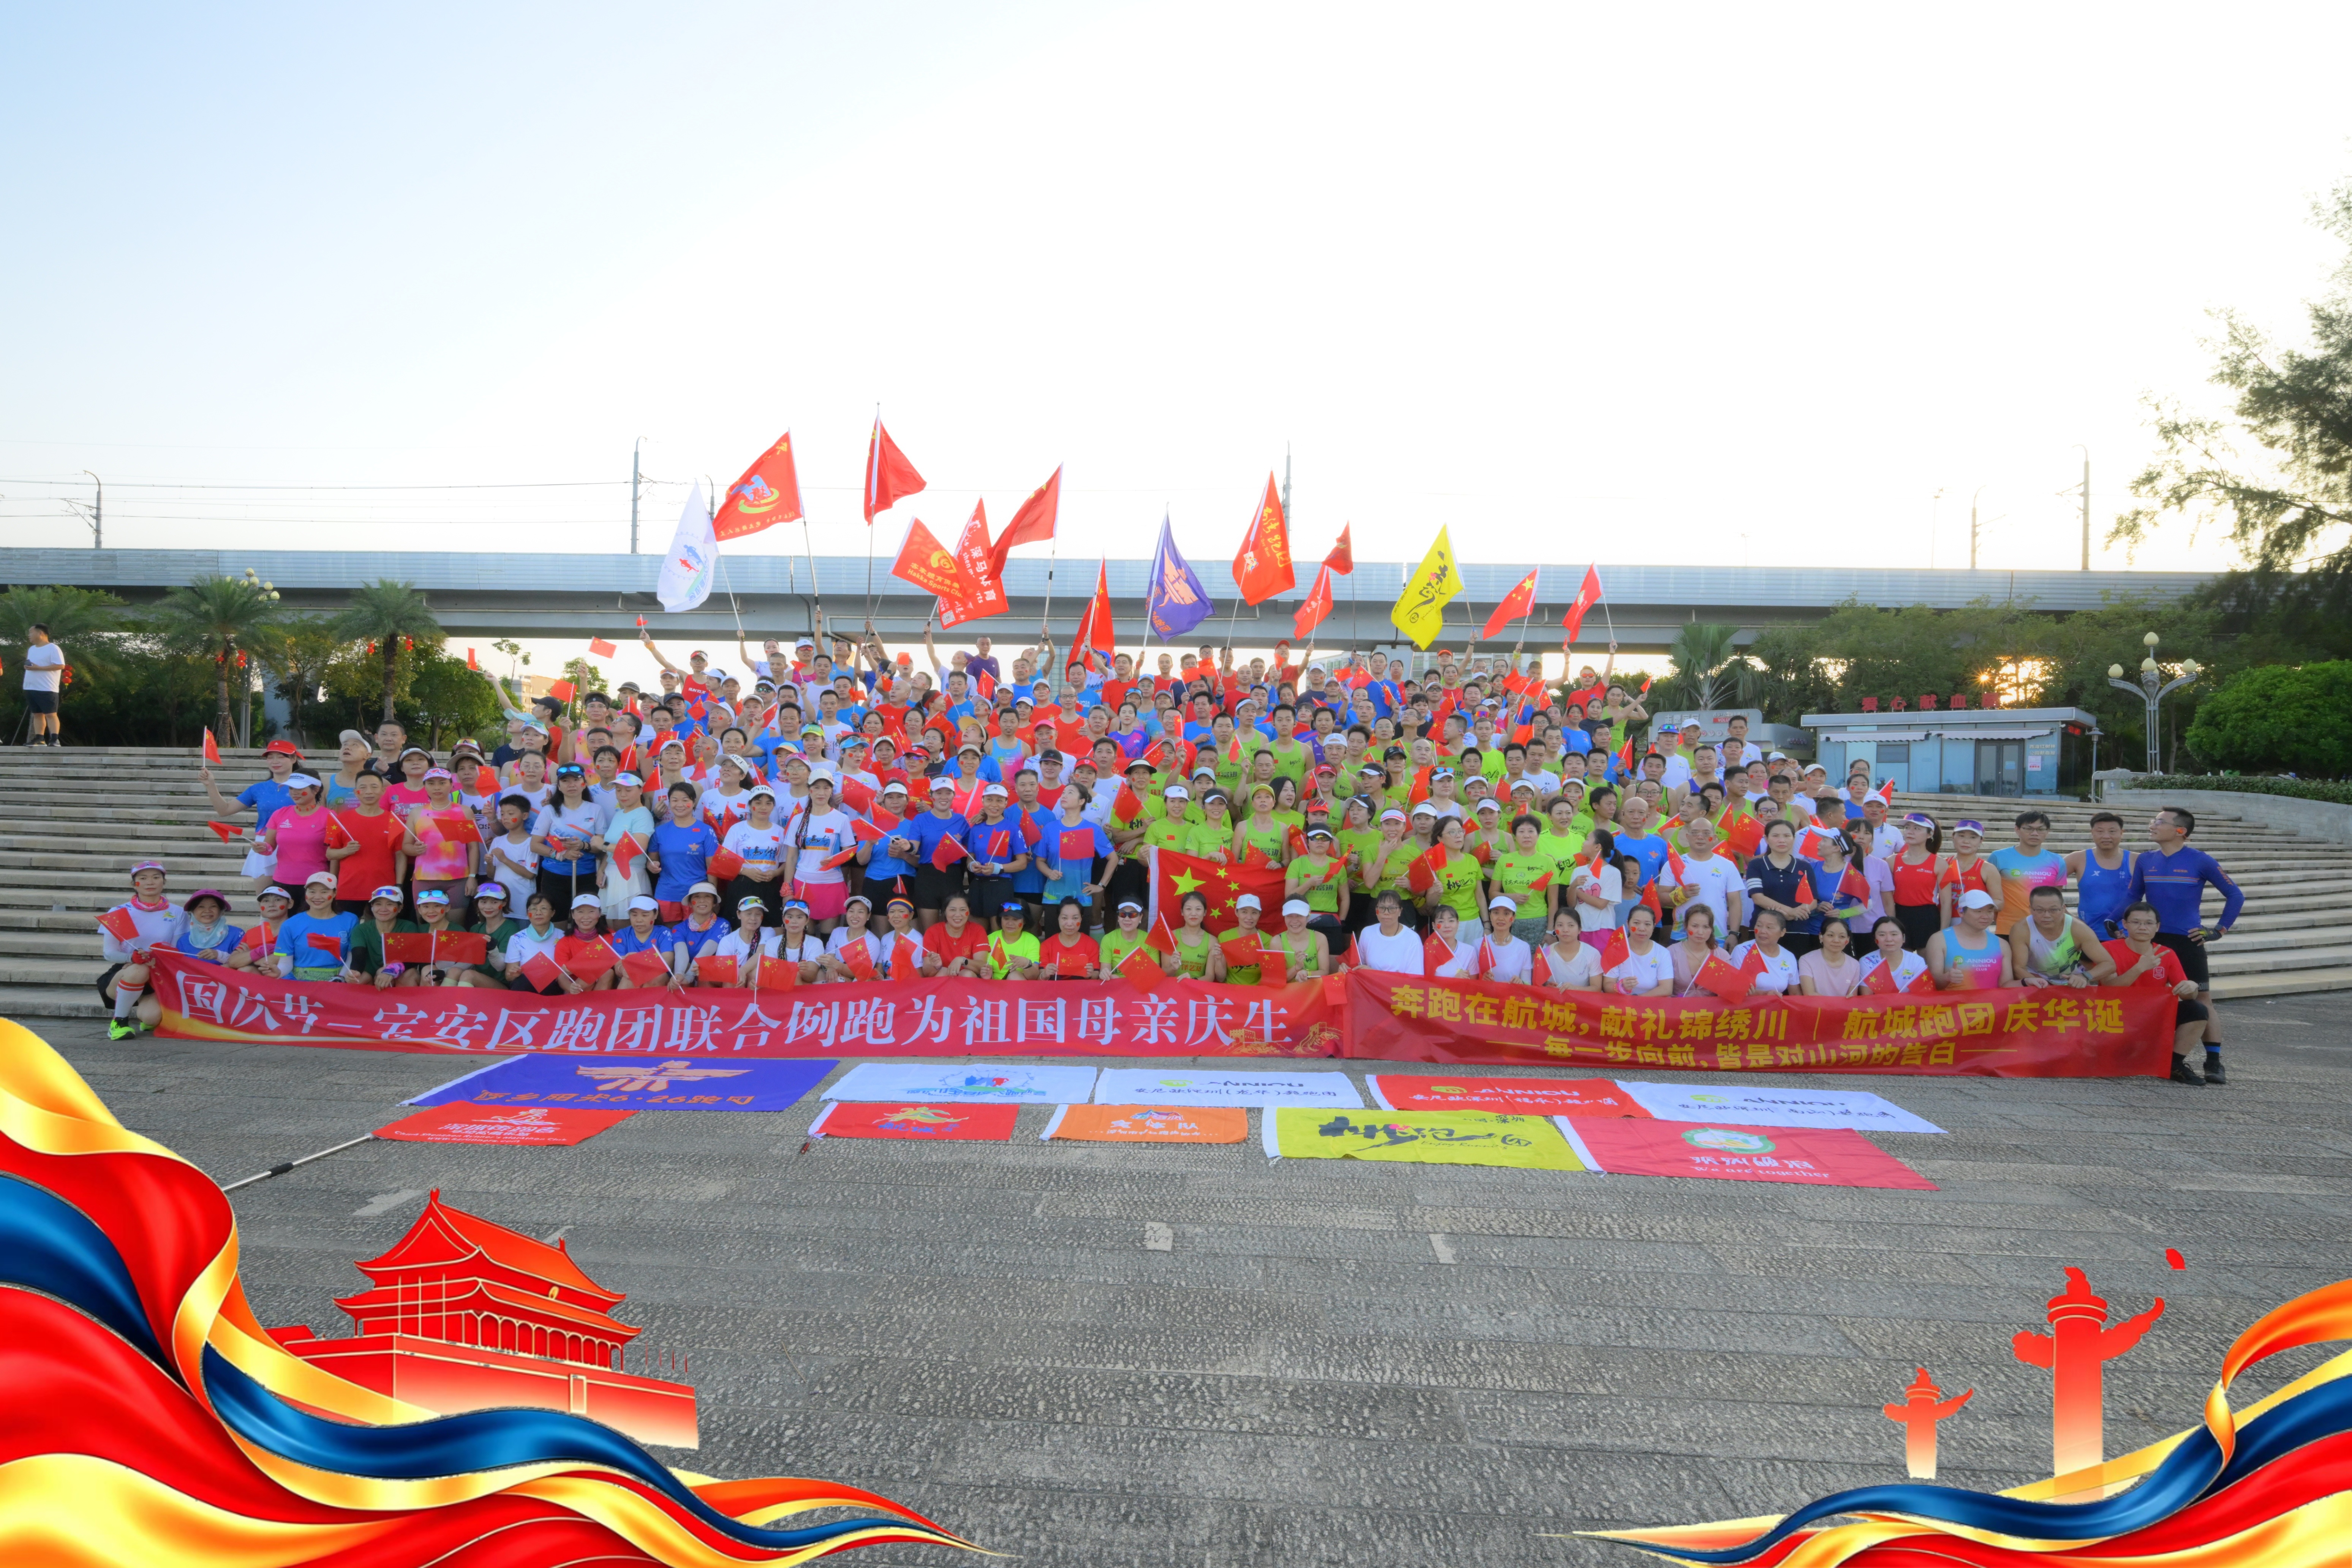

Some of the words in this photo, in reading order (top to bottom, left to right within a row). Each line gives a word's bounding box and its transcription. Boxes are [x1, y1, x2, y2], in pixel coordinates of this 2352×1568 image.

[907, 568, 928, 583] Hakka
[928, 580, 950, 593] Sports
[950, 588, 963, 598] Clu
[1861, 692, 2000, 711] 爱心献血屋
[1758, 1169, 1830, 1178] together
